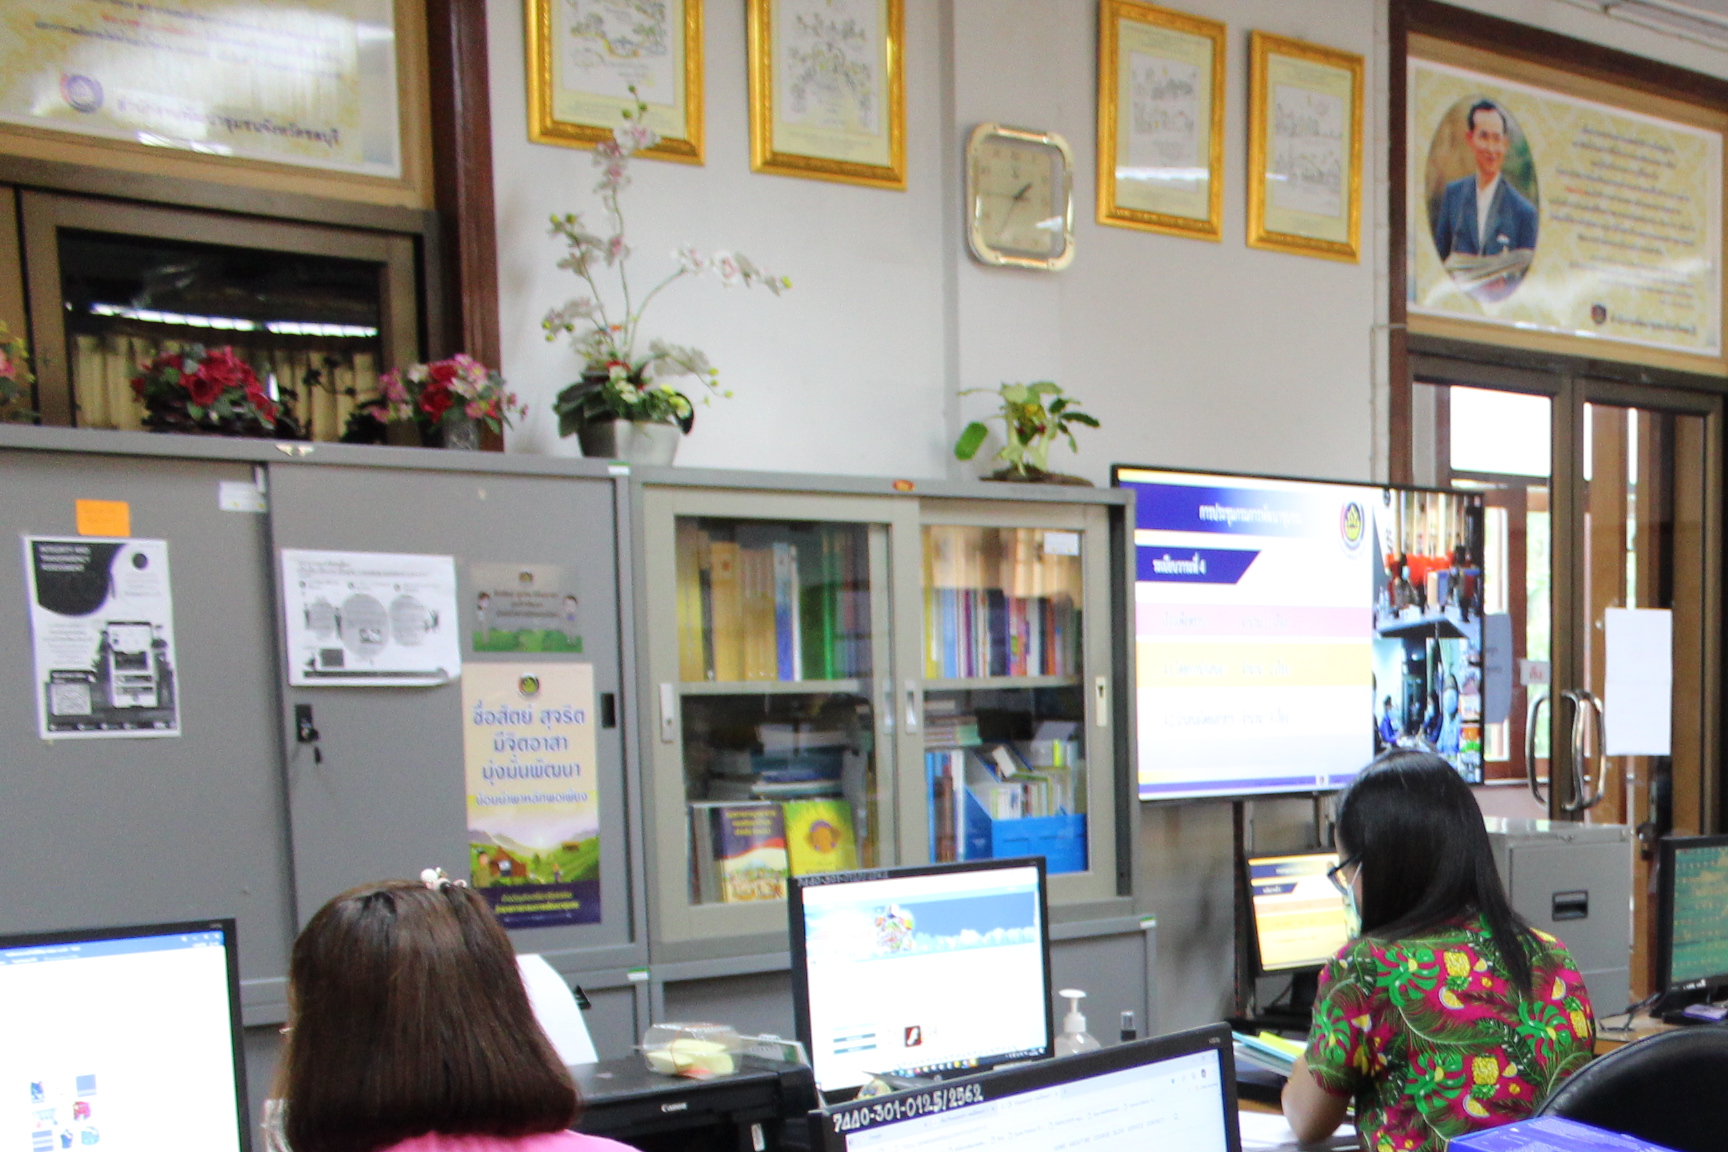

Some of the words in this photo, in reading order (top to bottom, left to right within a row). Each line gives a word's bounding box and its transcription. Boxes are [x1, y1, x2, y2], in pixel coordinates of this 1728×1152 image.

[472, 700, 532, 726] ซื่อสัตย์
[540, 704, 585, 730] สุจริต
[494, 731, 568, 753] มีจิตอาสา
[482, 754, 581, 786] มุ่งมั่นพัฒนา
